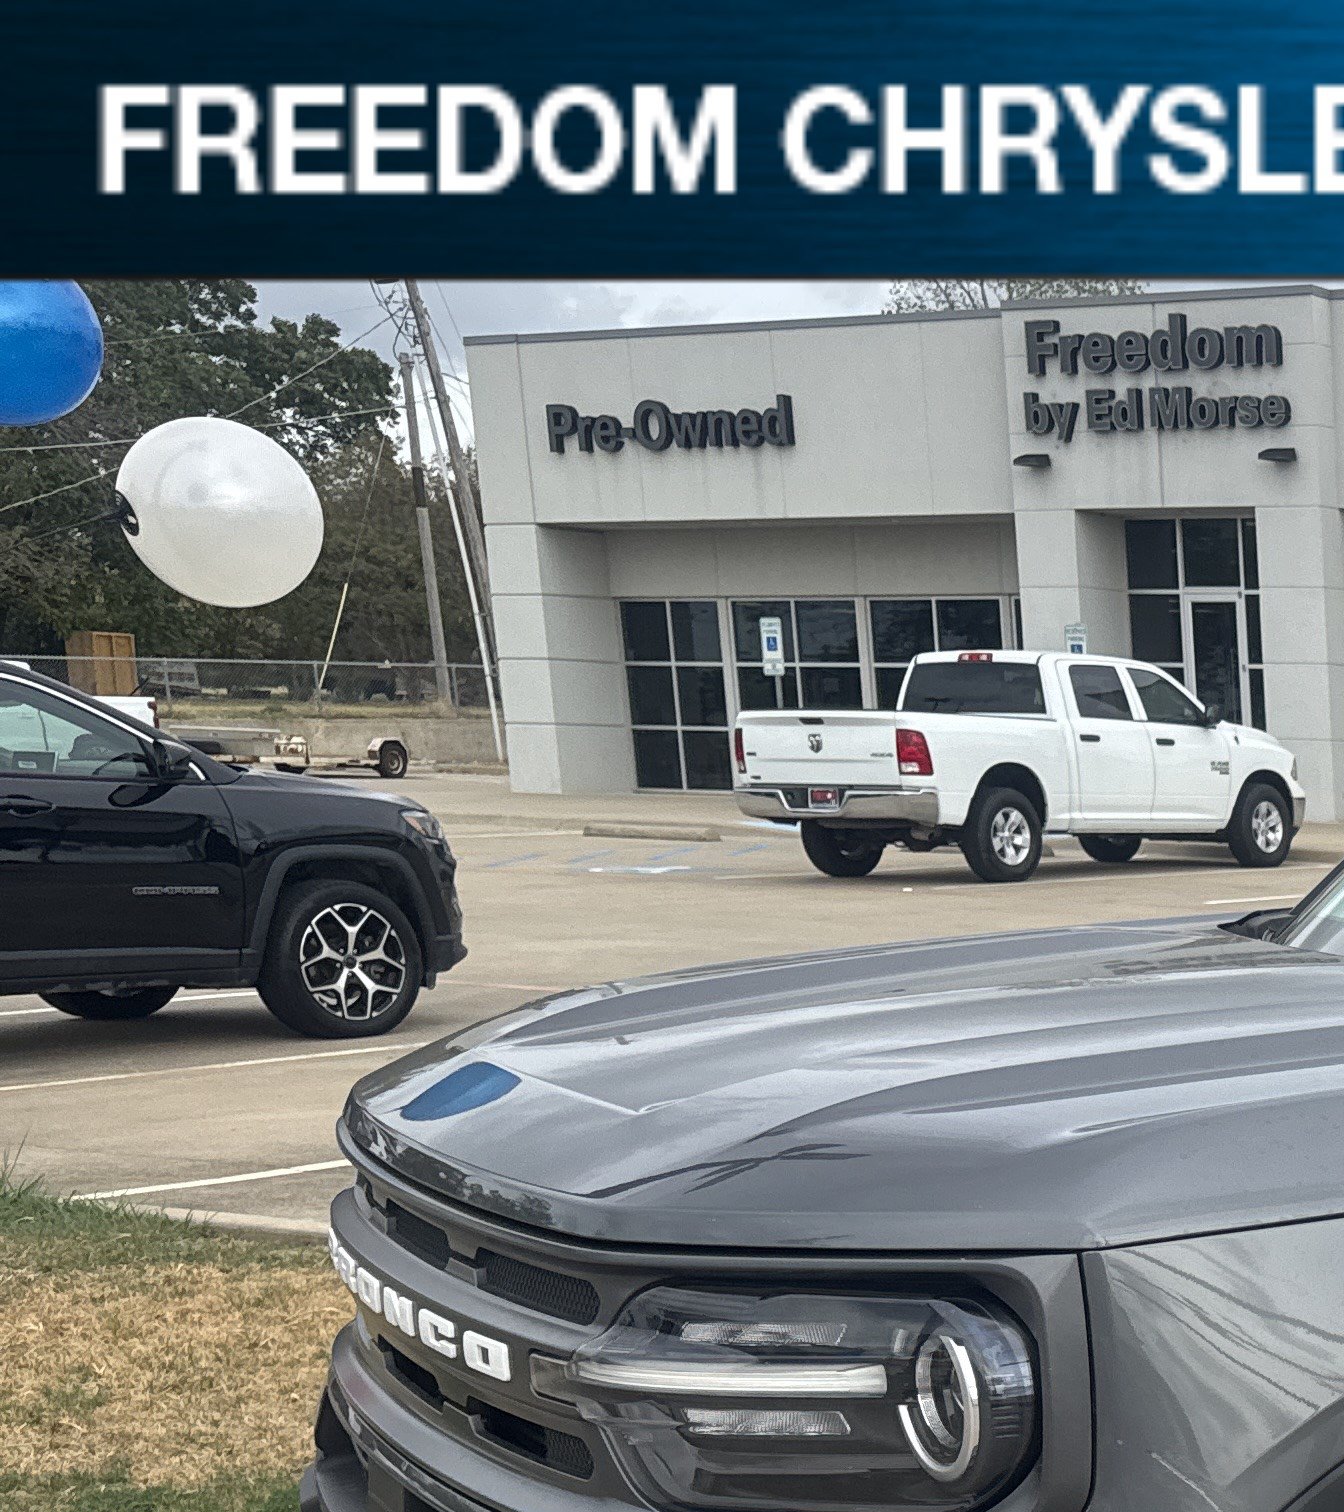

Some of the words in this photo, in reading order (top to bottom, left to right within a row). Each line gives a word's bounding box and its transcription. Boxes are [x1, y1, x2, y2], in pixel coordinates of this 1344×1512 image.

[1023, 313, 1284, 376] Freedom
[546, 394, 797, 454] Pre-Owned
[1023, 391, 1080, 443] by
[1086, 387, 1144, 432] Ed
[1150, 385, 1292, 429] Morse
